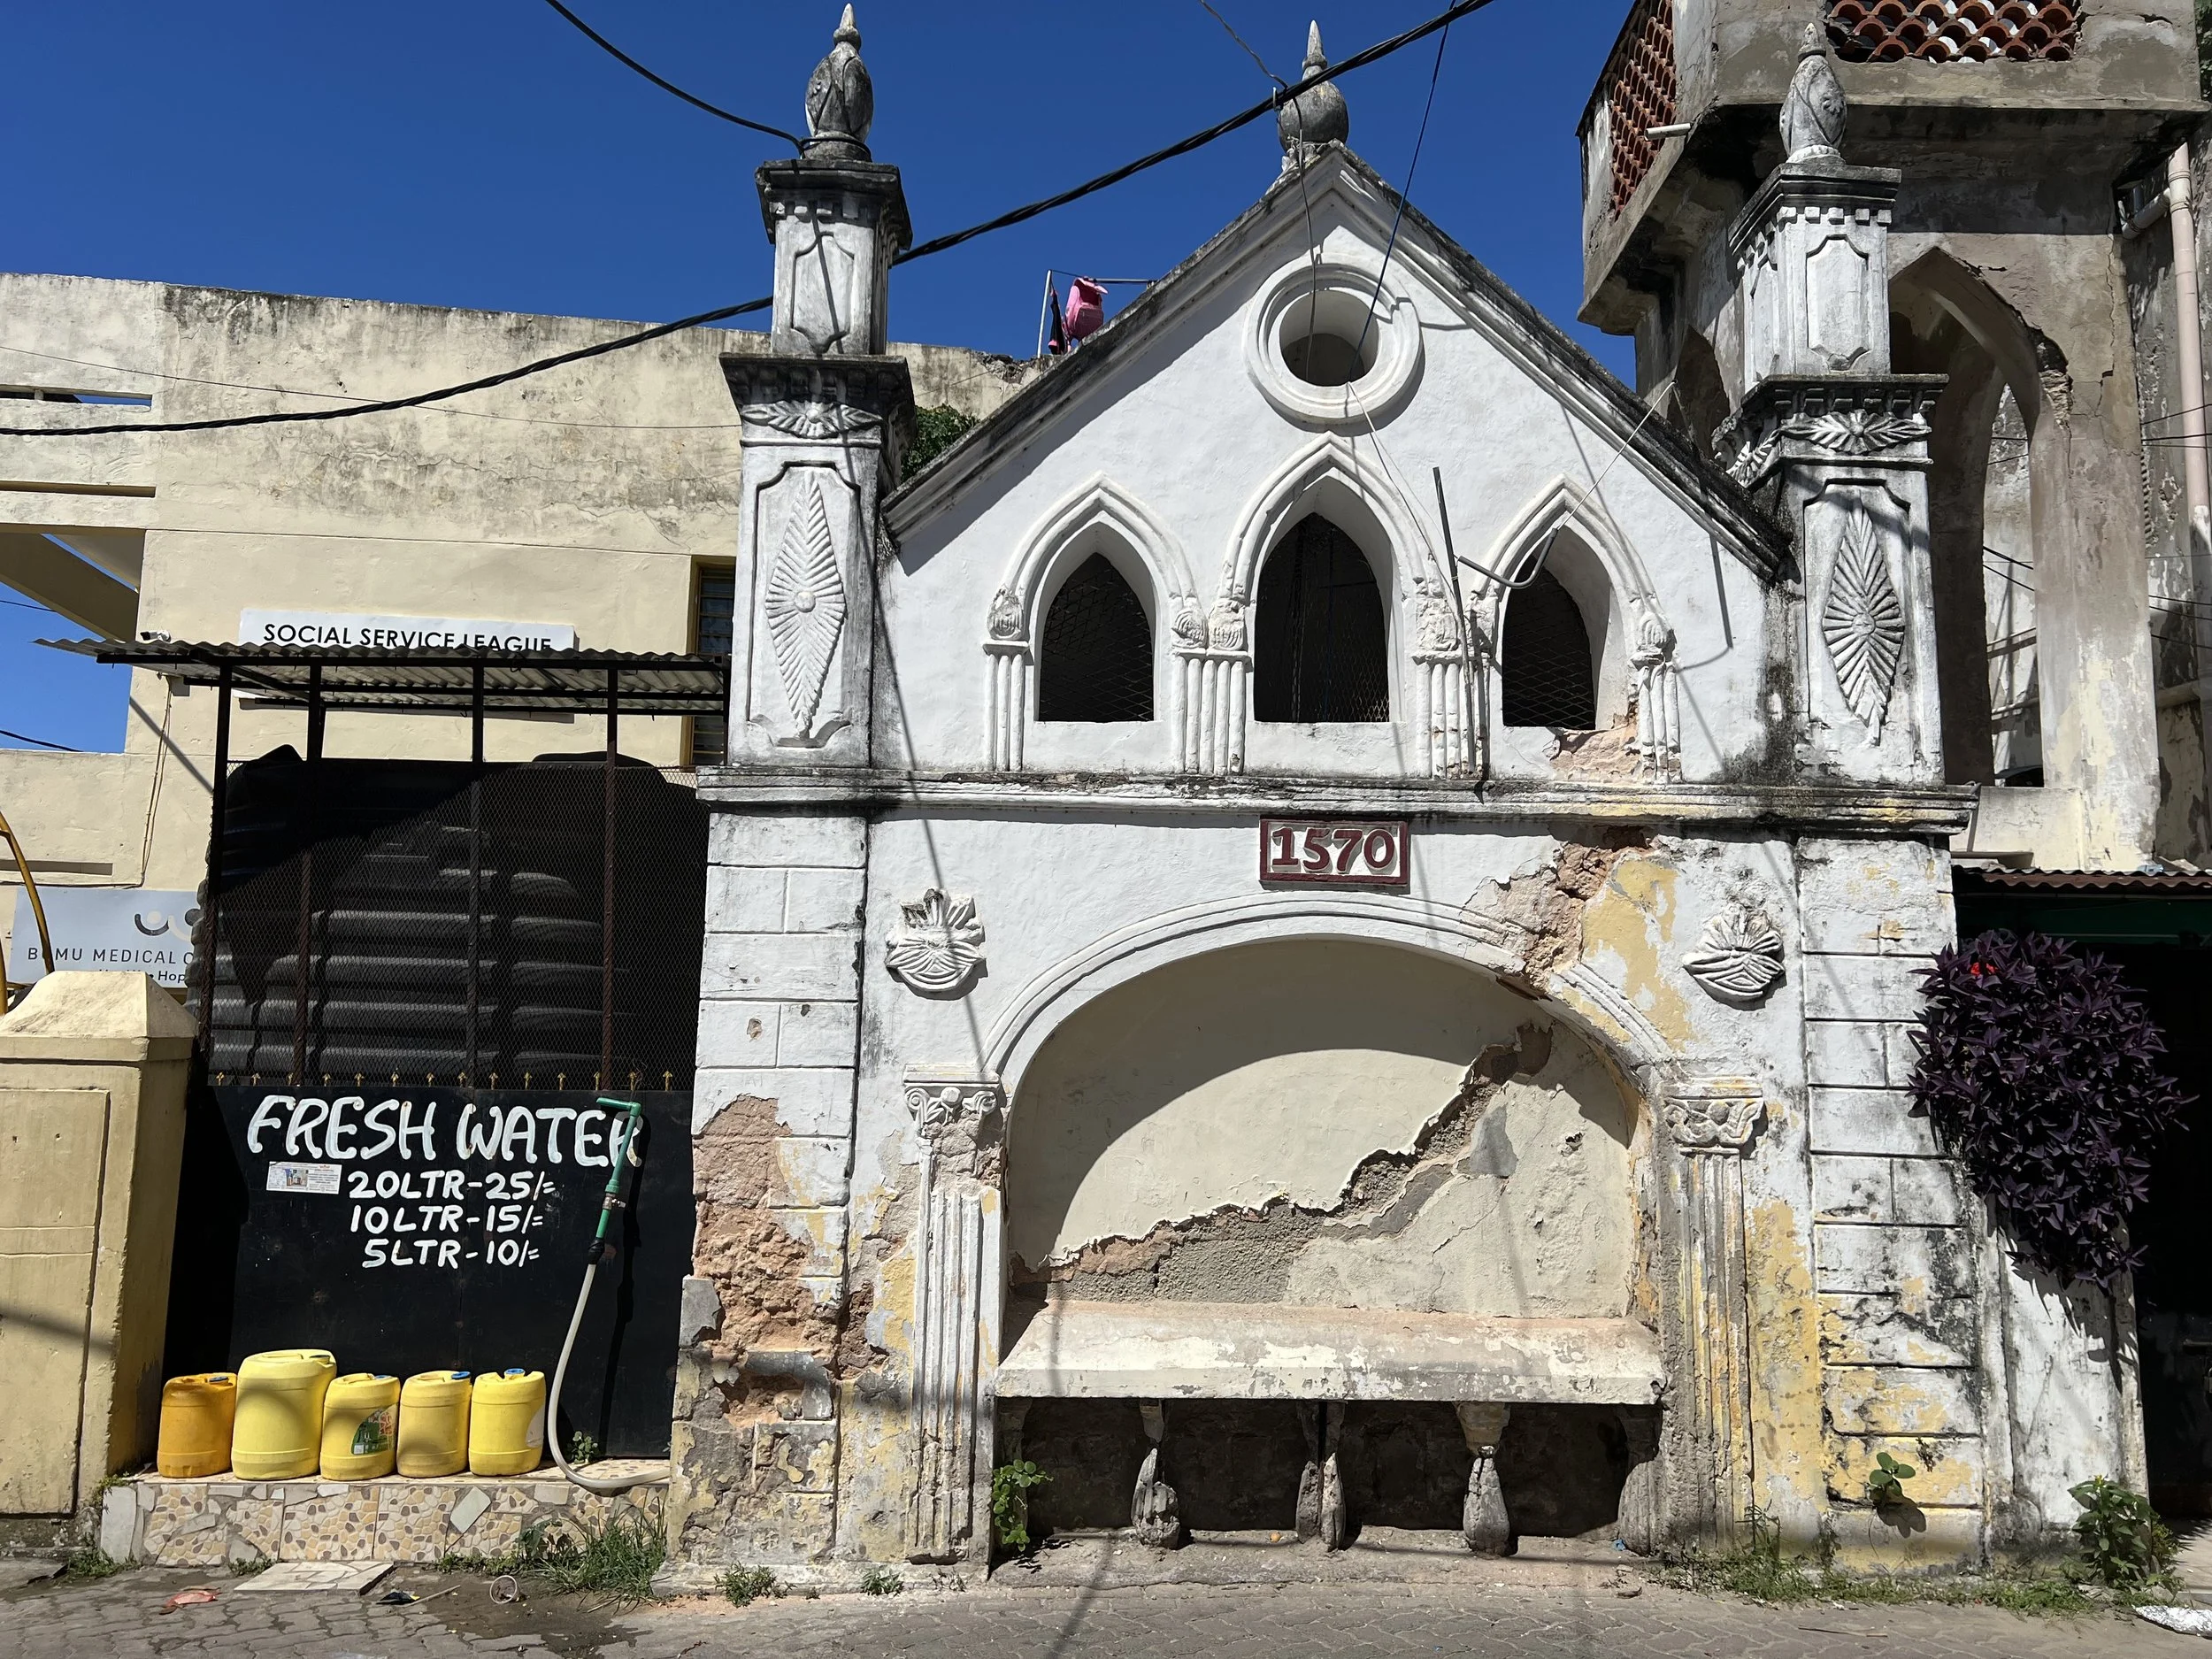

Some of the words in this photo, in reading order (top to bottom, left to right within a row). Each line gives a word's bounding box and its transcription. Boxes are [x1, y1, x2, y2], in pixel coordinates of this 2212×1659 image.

[264, 622, 352, 645] SOCIAL
[358, 626, 456, 649] SERVICE
[463, 633, 552, 651] LEAGUE
[1271, 826, 1395, 872] 1570
[27, 947, 83, 961] BMU
[92, 949, 177, 964] MEDICAL
[157, 970, 186, 984] Hop
[247, 1095, 437, 1160] FRESH
[456, 1102, 643, 1167] WATER
[347, 1170, 557, 1201] 20LTR-25/=
[350, 1204, 544, 1234] 10LTR-15/=
[362, 1238, 541, 1270] 5LTR-10/=
